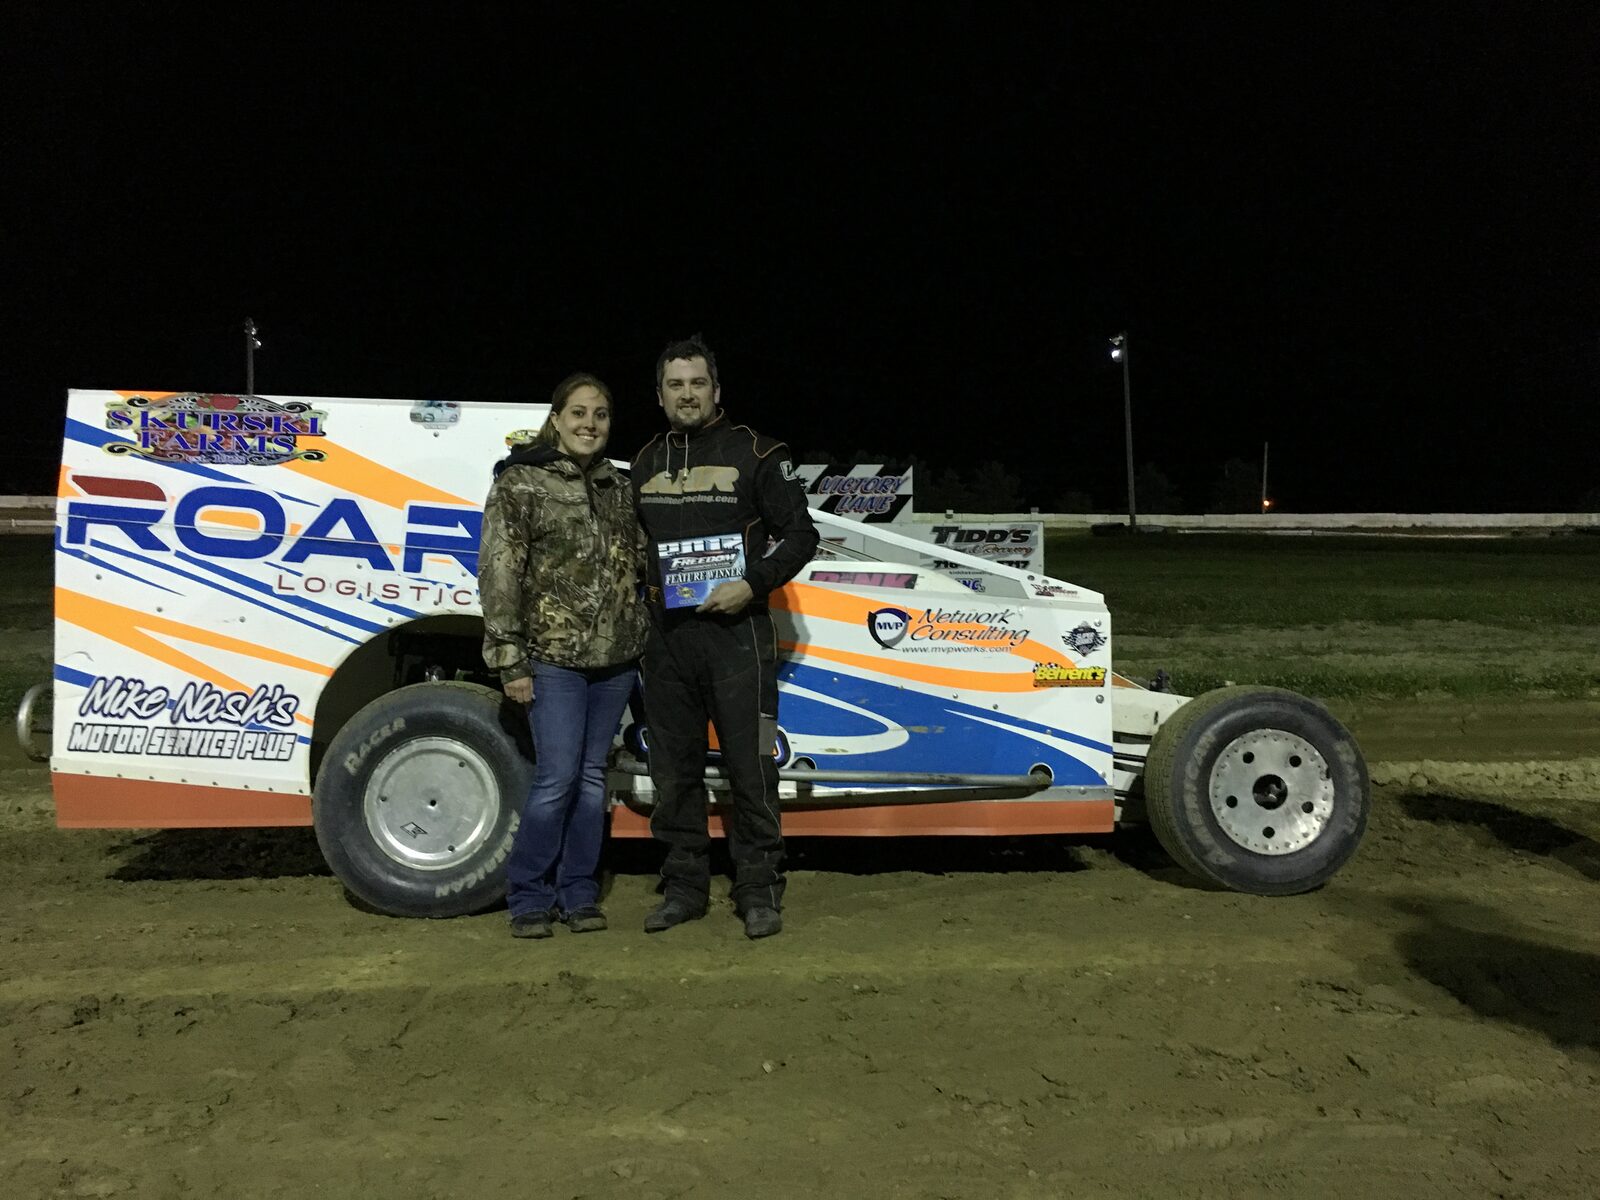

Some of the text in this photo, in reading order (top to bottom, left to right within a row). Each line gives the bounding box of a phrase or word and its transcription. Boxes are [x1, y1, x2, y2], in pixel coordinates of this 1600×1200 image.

[109, 409, 322, 435] SKURSKI
[139, 429, 296, 454] FARMS
[817, 475, 911, 495] VICTORY
[834, 494, 897, 514] LANE
[66, 474, 484, 574] ROAR
[931, 525, 1032, 544] TIDD'S
[665, 571, 706, 586] FEATURE
[705, 567, 745, 580] WINNER
[876, 622, 903, 631] MVP
[918, 608, 1016, 625] Network
[910, 625, 1031, 647] Consulting
[902, 645, 1013, 654] www.mvpworks.com
[79, 676, 299, 727] Mike Nash's
[67, 722, 298, 761] MOTOR SERVICE PLUS
